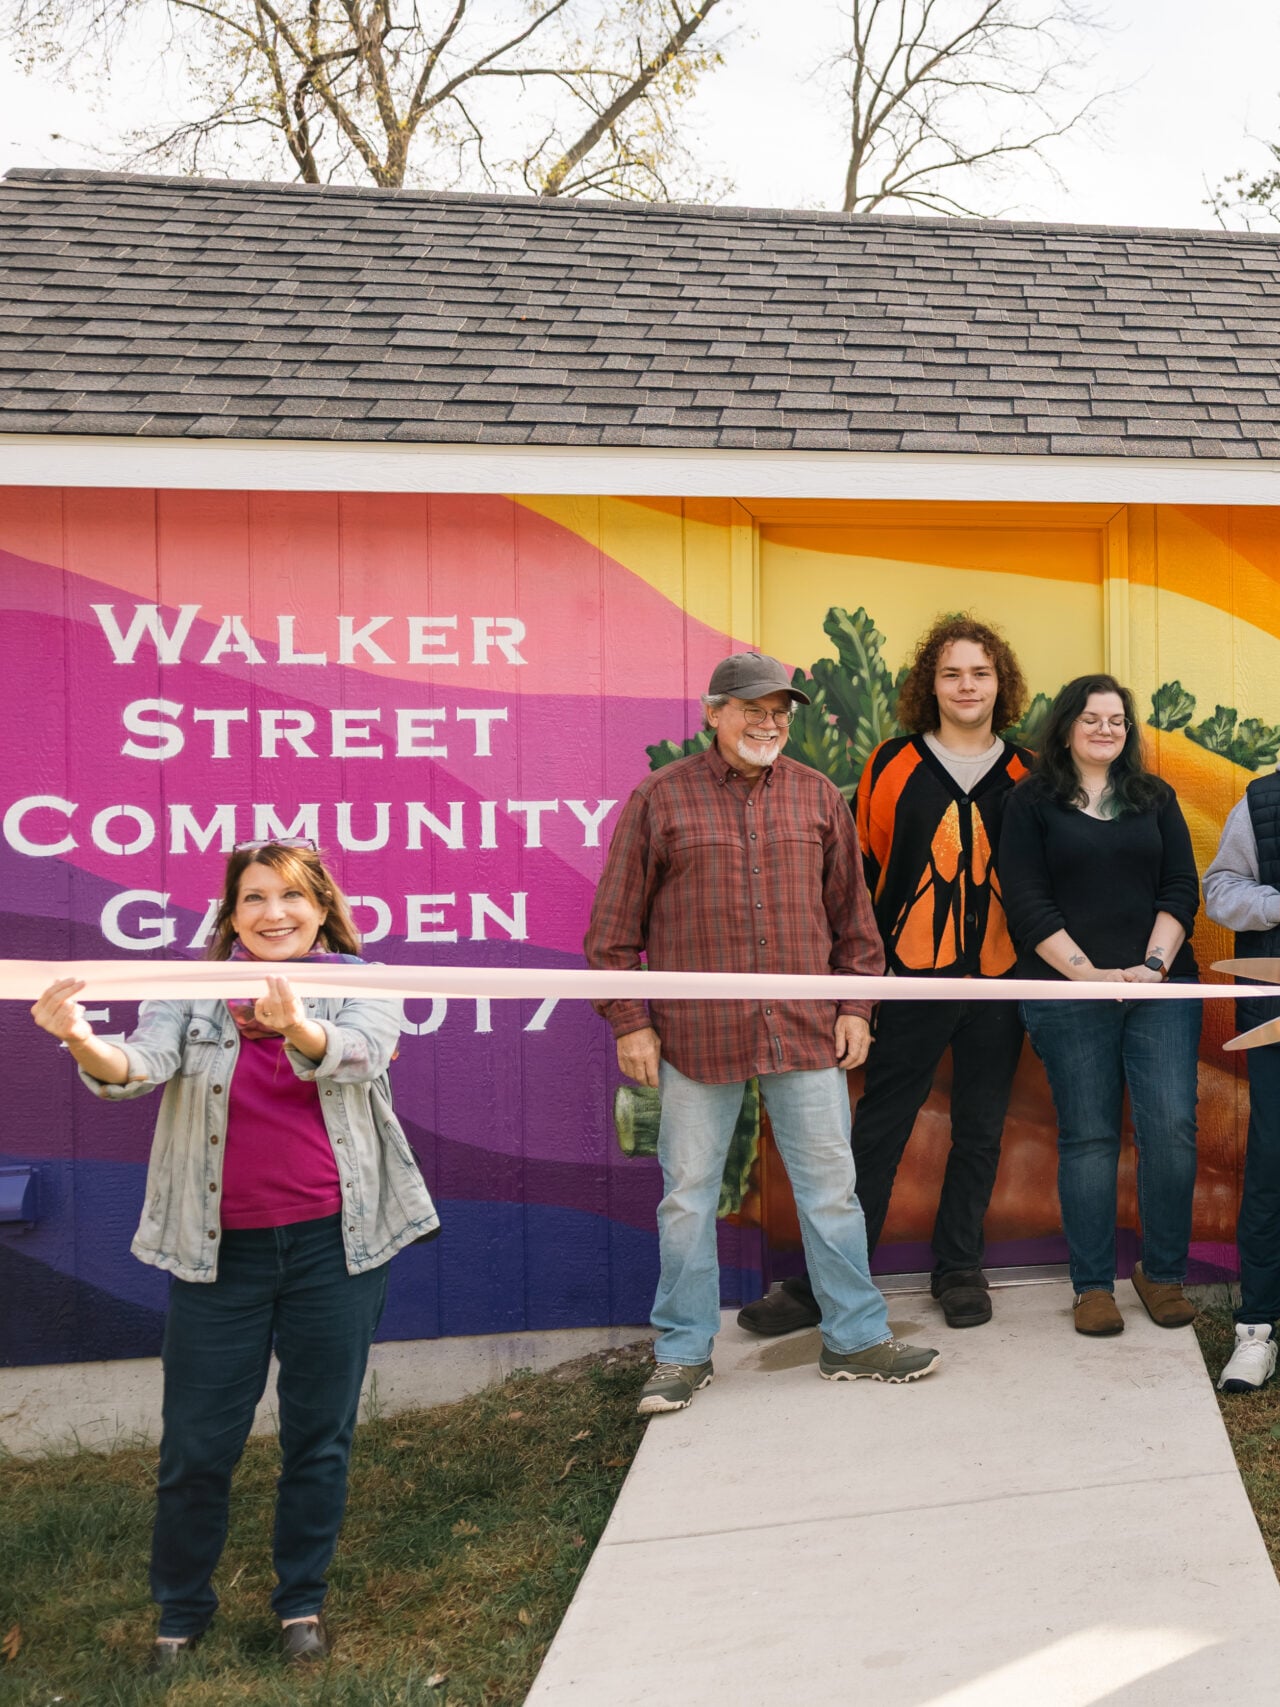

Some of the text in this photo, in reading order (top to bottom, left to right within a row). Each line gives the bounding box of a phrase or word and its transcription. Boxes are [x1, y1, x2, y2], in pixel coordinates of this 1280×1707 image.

[90, 604, 528, 666] WALKER
[120, 698, 509, 761] STREET
[2, 795, 619, 858] COMMUNITY
